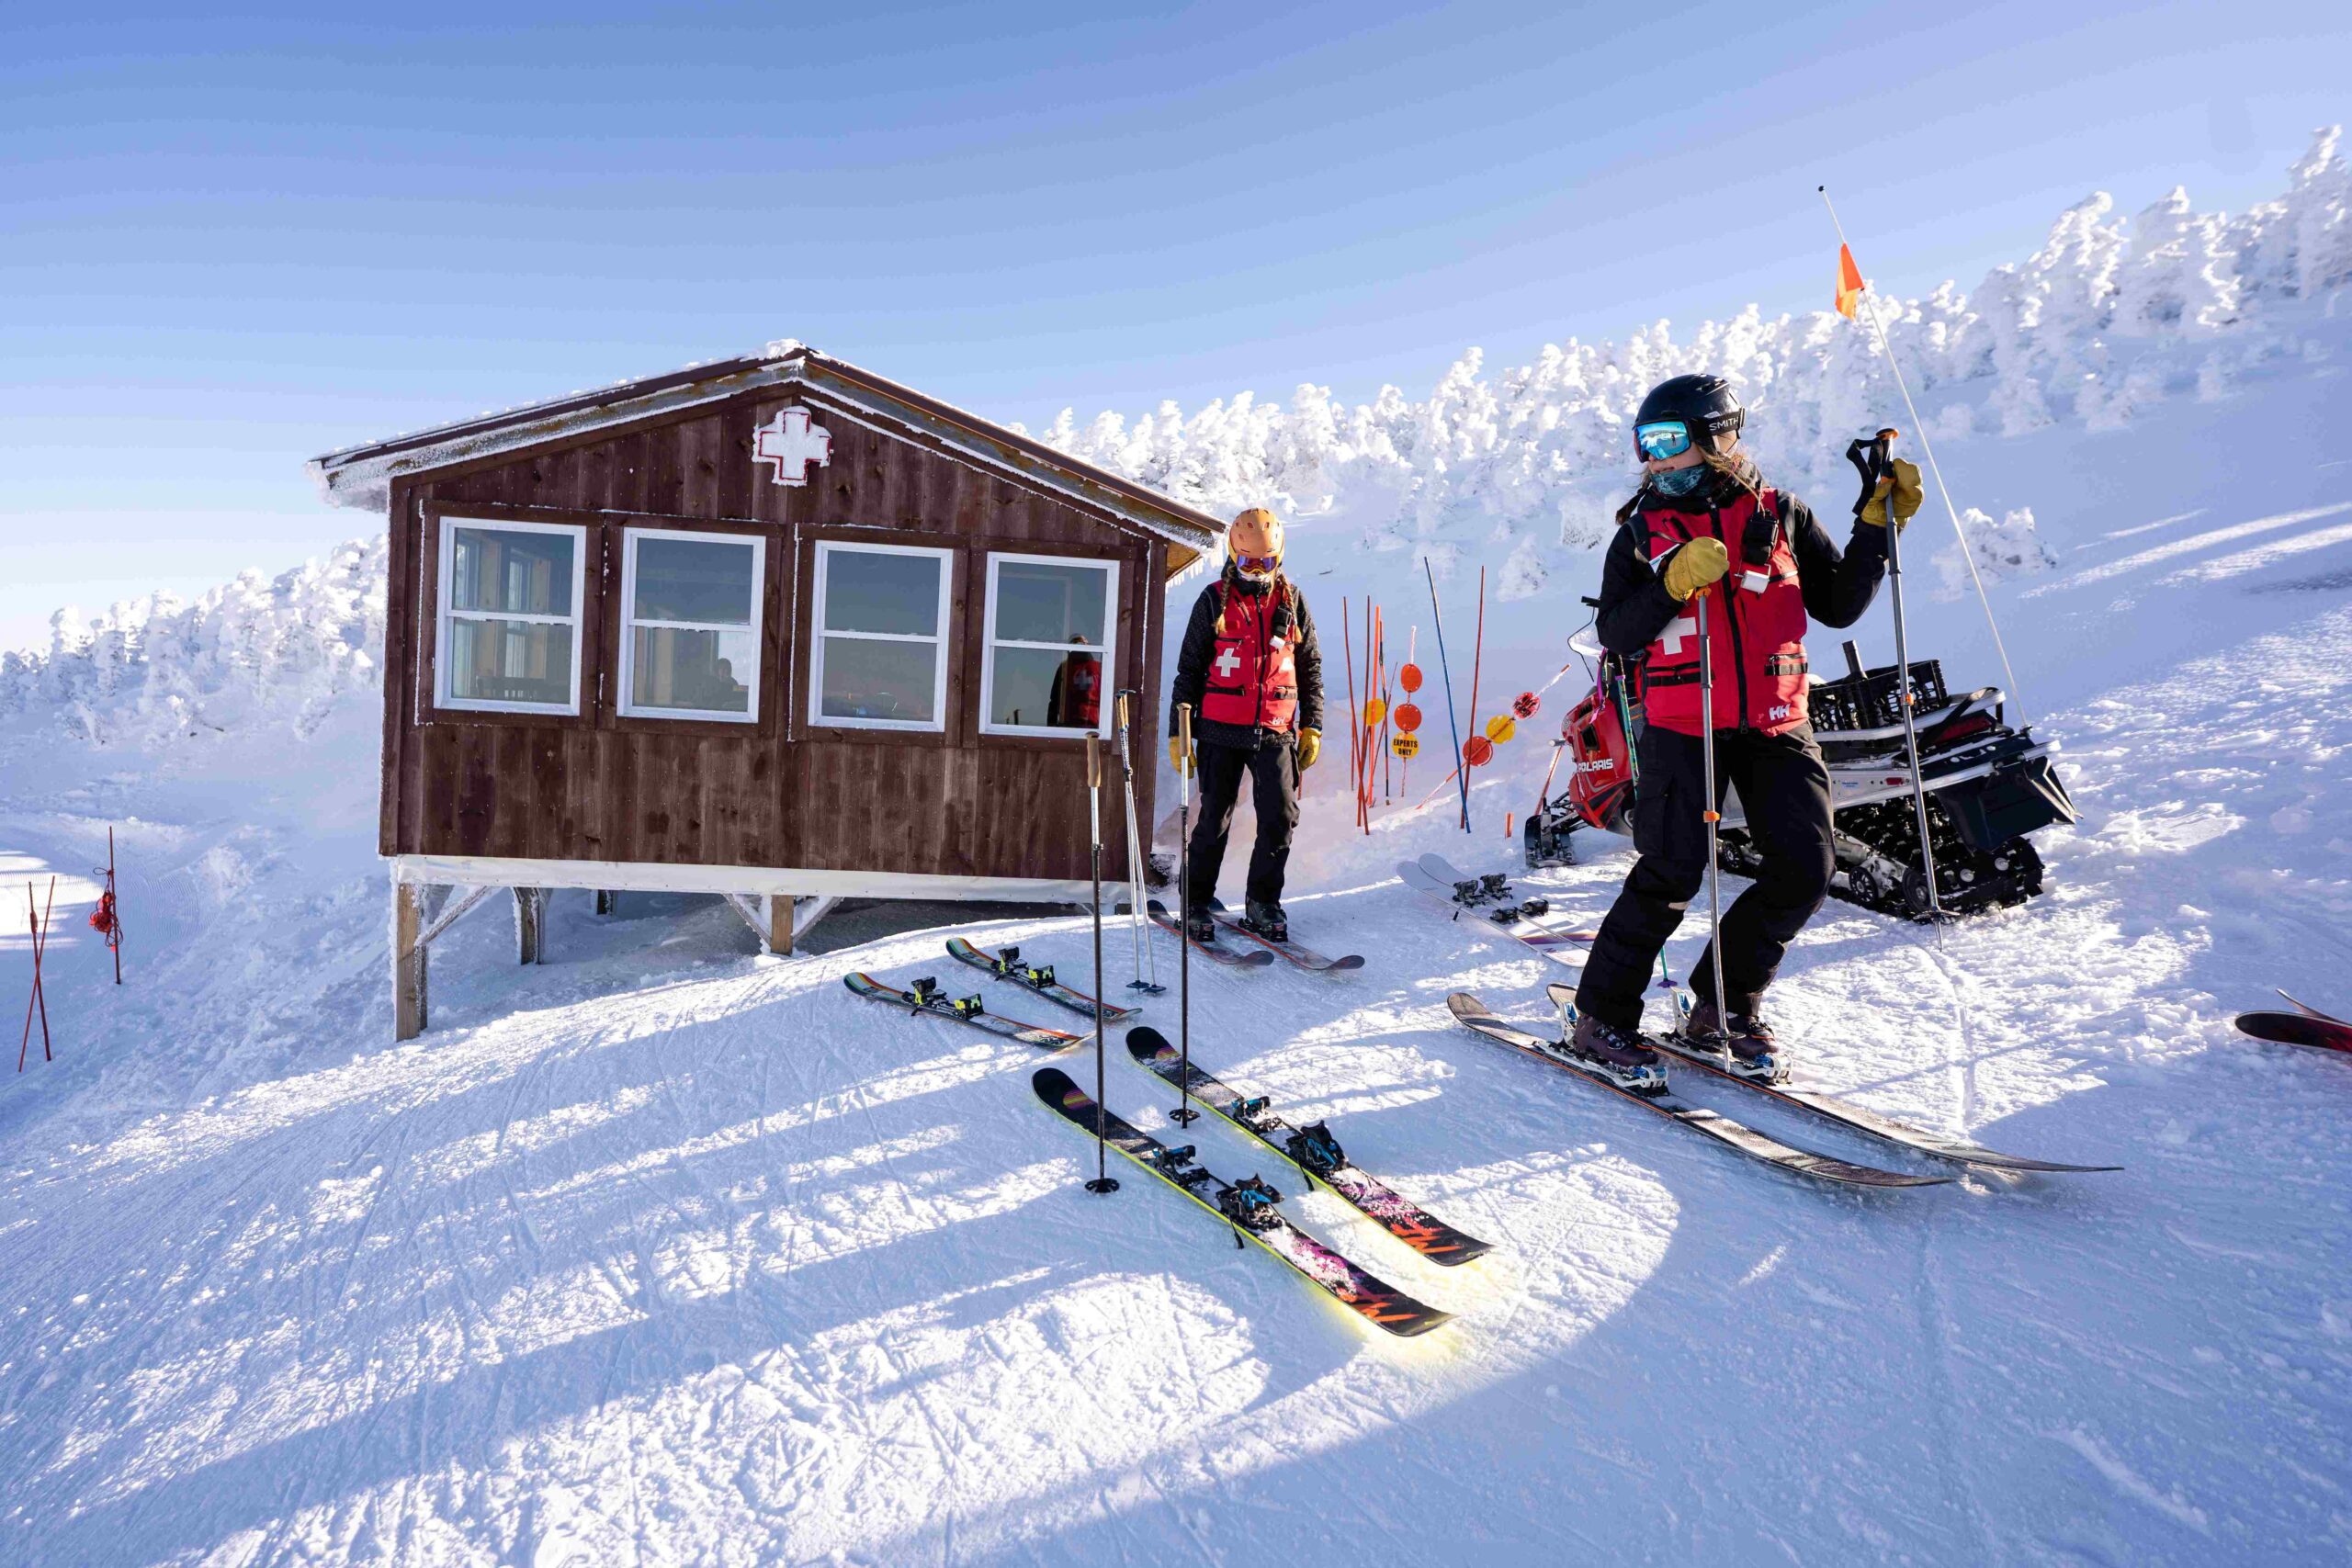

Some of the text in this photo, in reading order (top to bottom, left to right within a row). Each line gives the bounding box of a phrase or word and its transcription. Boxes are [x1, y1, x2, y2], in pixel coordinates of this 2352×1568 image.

[1709, 416, 1738, 431] SMITH
[1770, 704, 1791, 721] HH
[1393, 739, 1418, 749] EXPERTS
[1398, 748, 1412, 756] ONLY
[1577, 758, 1613, 773] POLARIS
